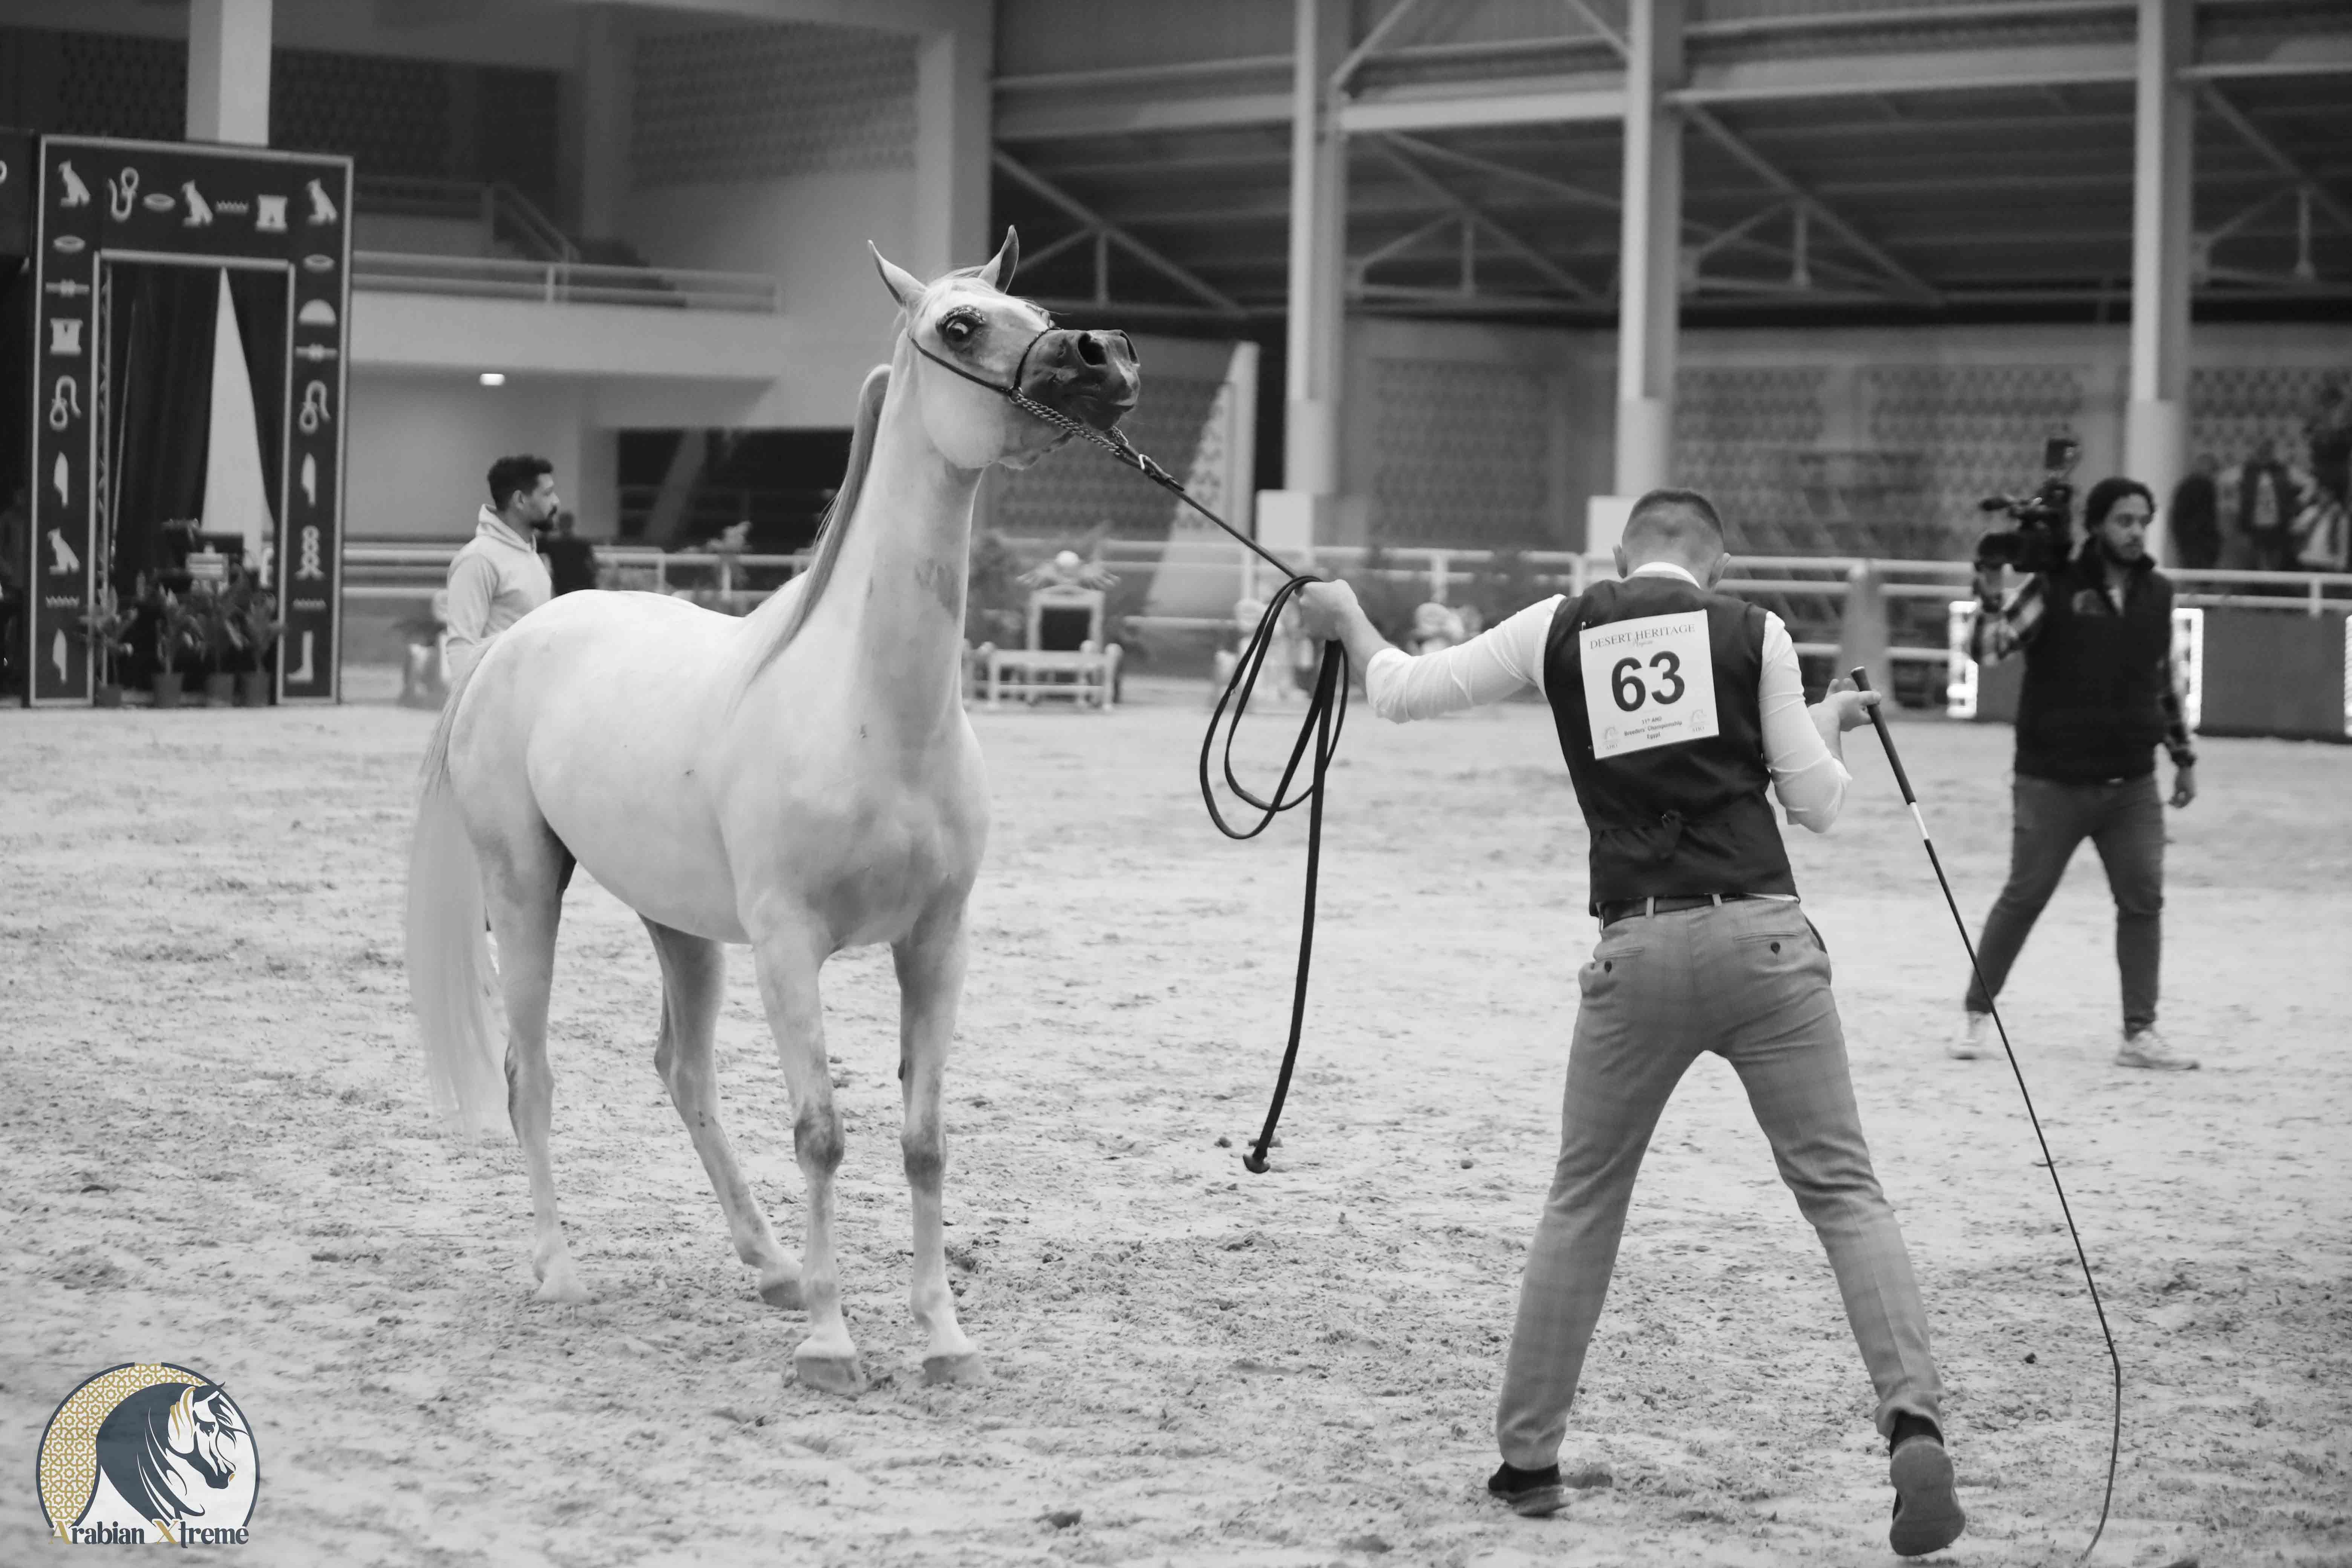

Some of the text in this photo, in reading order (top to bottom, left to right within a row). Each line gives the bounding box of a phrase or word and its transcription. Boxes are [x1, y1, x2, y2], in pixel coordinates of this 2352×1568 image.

[1589, 632, 1632, 650] DESERT
[1635, 624, 1695, 640] HERITAGE
[1611, 650, 1685, 712] 63
[1647, 720, 1683, 731] Championship
[1646, 732, 1660, 740] Egypt
